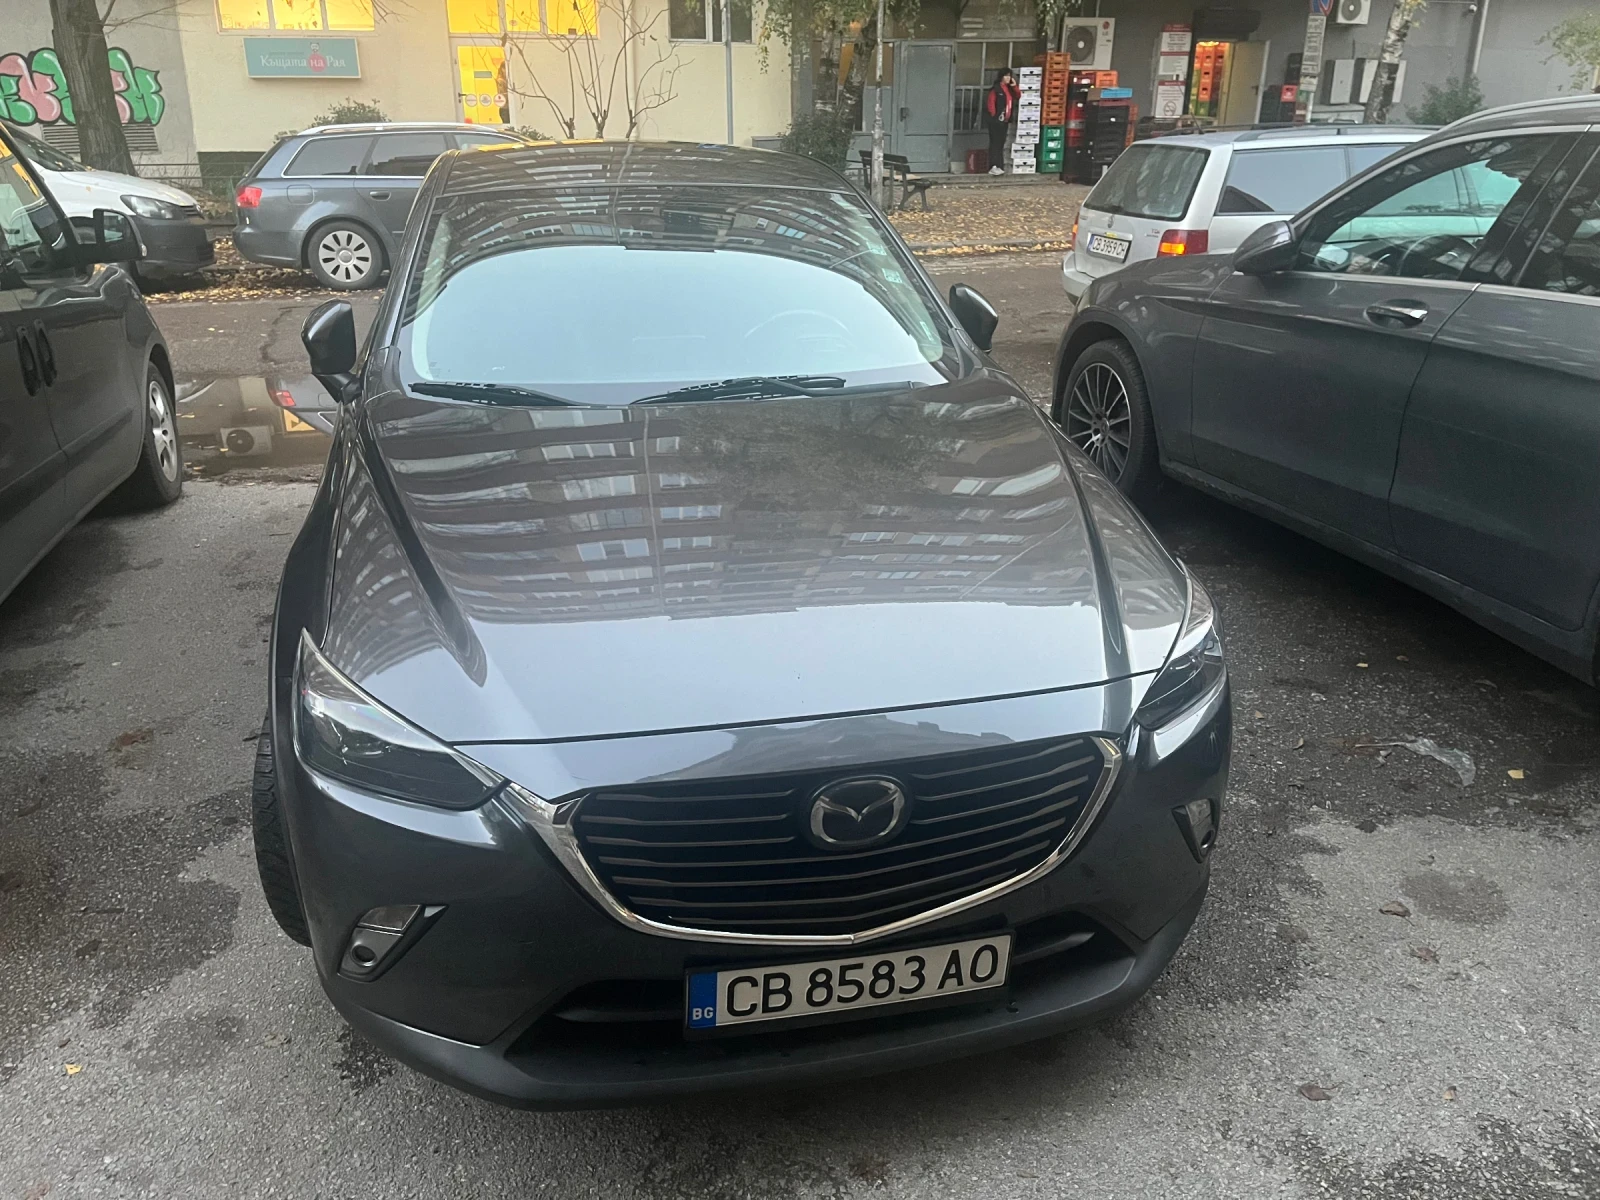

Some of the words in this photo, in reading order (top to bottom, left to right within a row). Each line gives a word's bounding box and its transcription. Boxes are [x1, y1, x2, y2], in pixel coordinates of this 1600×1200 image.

[260, 55, 307, 69] Къщата
[310, 59, 325, 67] на
[326, 55, 346, 67] Рая
[1101, 239, 1117, 254] 3959
[727, 972, 793, 1017] CB
[806, 955, 925, 1007] 8583
[937, 944, 999, 990] AO
[692, 1007, 714, 1020] BG
